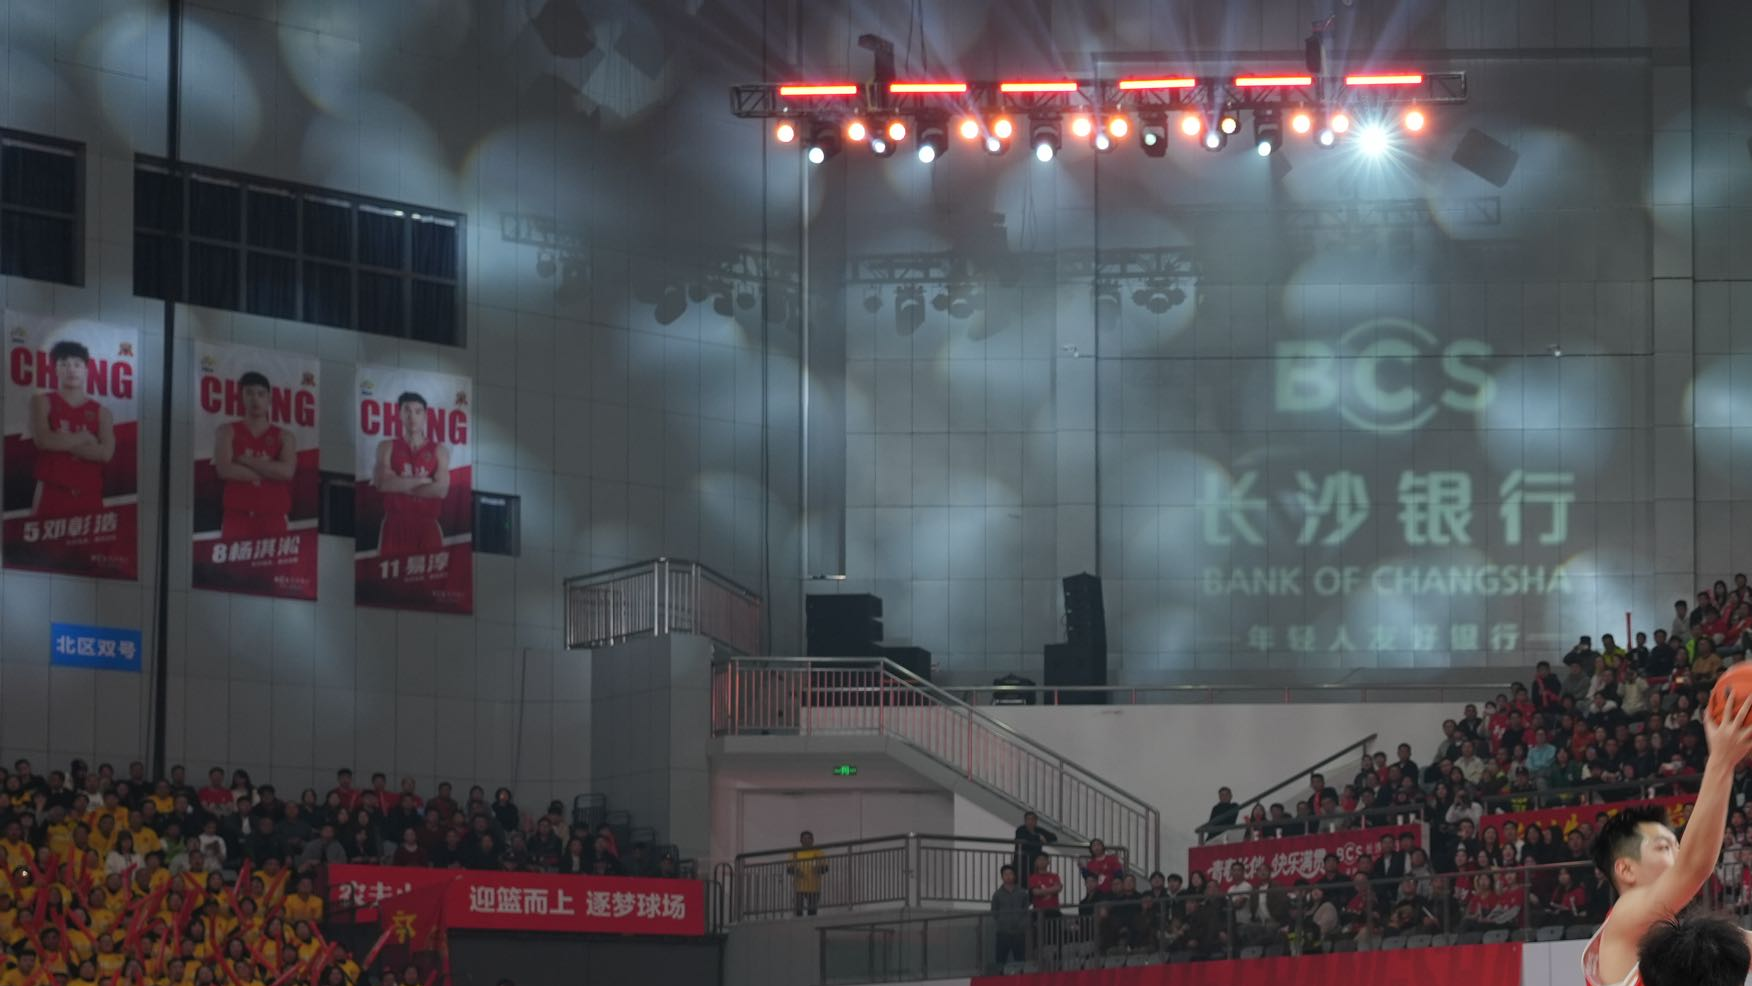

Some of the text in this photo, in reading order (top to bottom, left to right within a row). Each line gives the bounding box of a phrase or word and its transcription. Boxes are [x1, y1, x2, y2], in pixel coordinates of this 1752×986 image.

[10, 345, 134, 399] CHNG
[1273, 338, 1498, 414] BCS
[200, 375, 315, 427] CHNG
[361, 399, 467, 445] CHNG
[1196, 469, 1576, 546] 长沙银行
[1203, 565, 1575, 596] BANK OF CHANGSHA
[56, 634, 137, 660] 北区双号
[1247, 622, 1520, 652] 年轻人友好银行
[469, 886, 686, 920] 迎篮而上 逐梦球场
